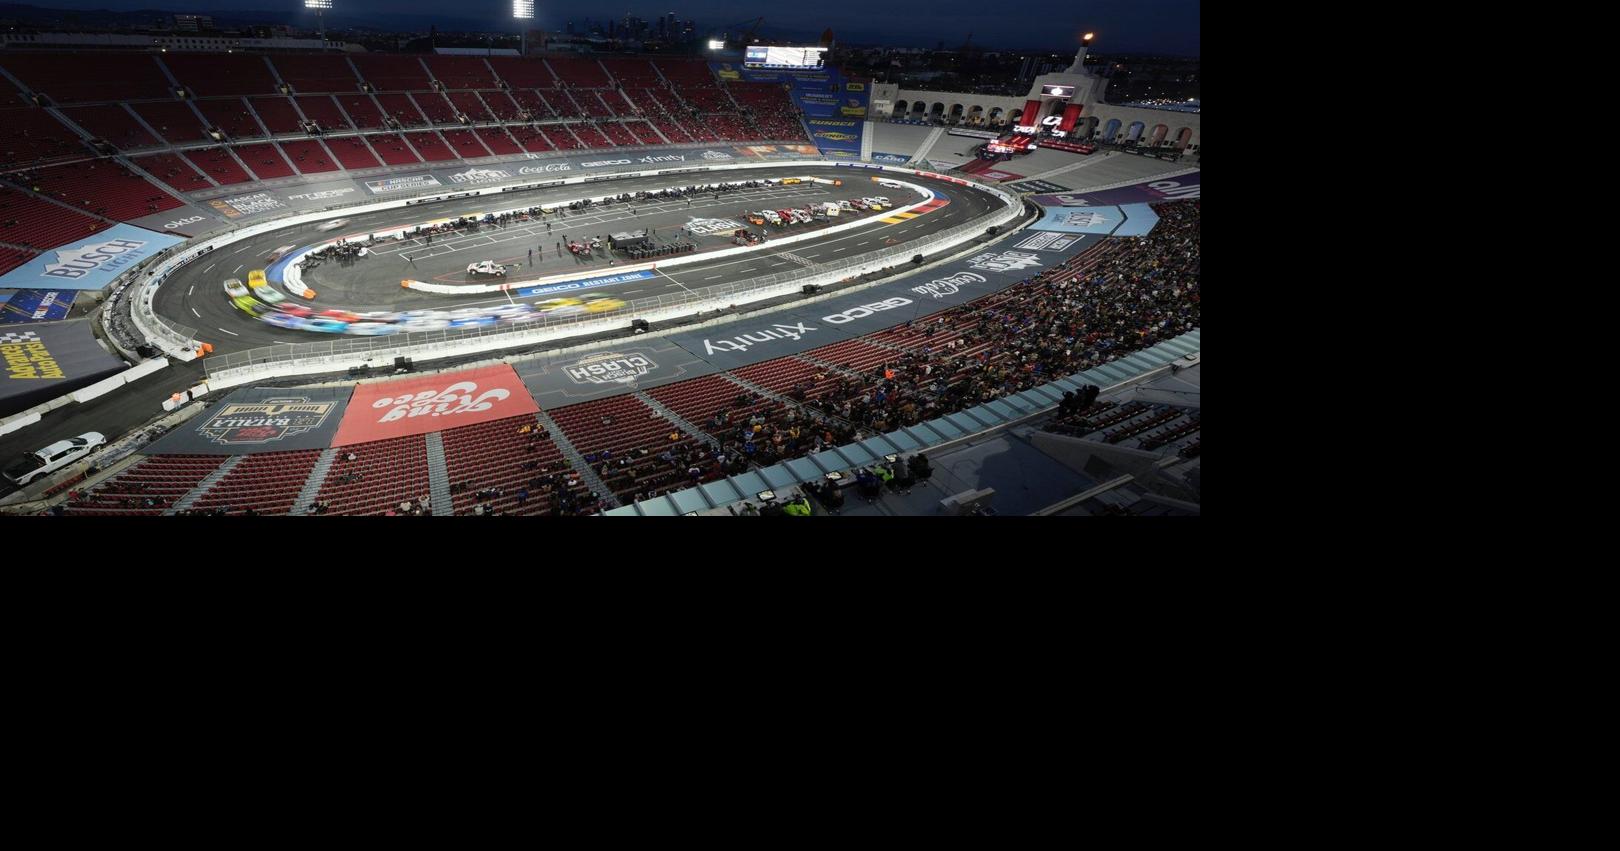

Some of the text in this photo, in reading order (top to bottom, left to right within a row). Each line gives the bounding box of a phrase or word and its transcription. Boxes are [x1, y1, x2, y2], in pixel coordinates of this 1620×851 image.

[581, 159, 631, 167] GEICO
[639, 153, 685, 164] xfinity
[164, 215, 206, 229] okta
[46, 239, 143, 279] BUSCH
[99, 249, 144, 273] LIGHT
[531, 283, 581, 294] GEICO
[583, 278, 620, 287] RESTART
[822, 297, 913, 325] GEICO
[704, 321, 818, 356] xfinity
[0, 344, 40, 379] Advance
[25, 343, 66, 379] Auto Parts
[569, 356, 649, 379] CLASH
[377, 388, 511, 424] King
[213, 418, 290, 428] BATALLA
